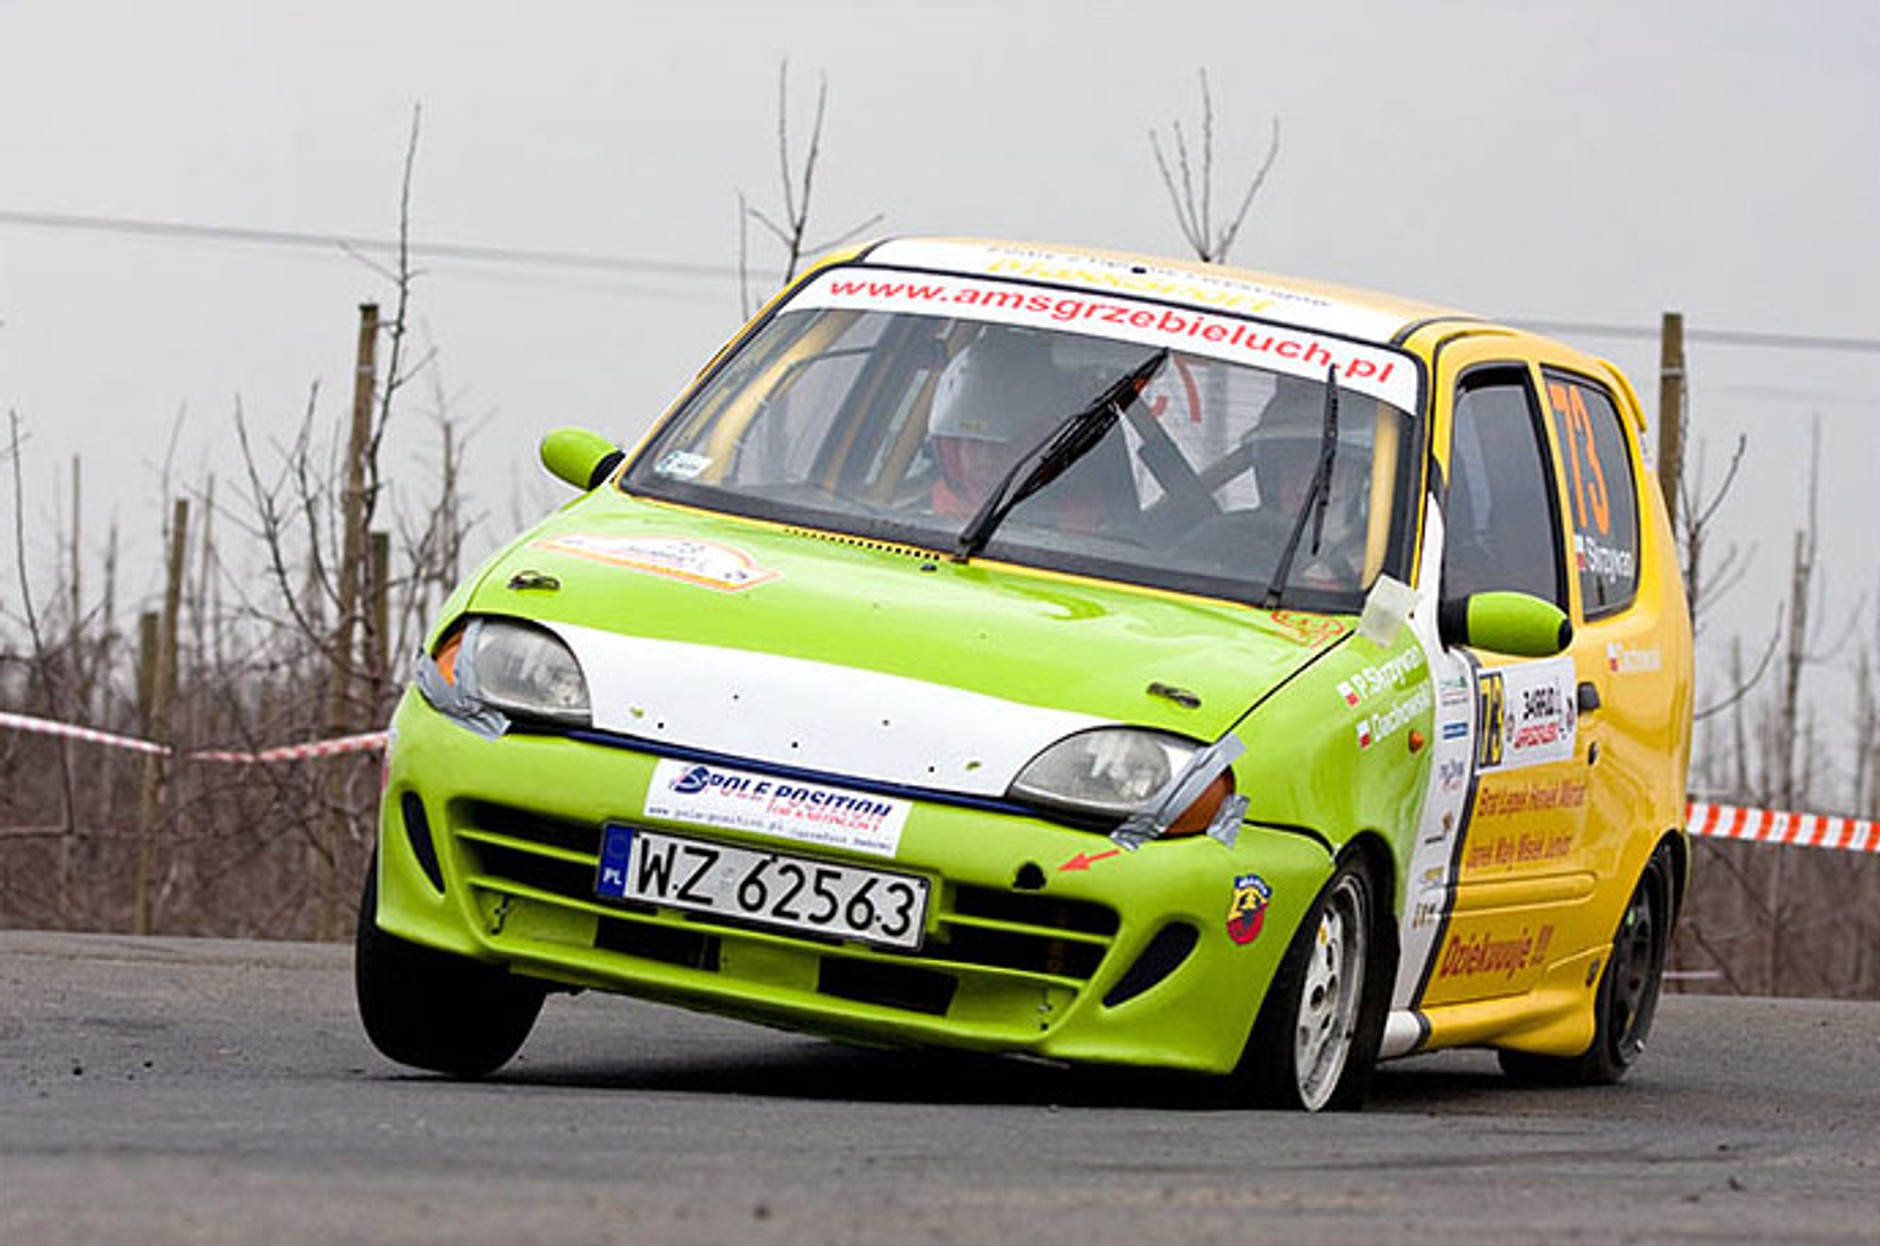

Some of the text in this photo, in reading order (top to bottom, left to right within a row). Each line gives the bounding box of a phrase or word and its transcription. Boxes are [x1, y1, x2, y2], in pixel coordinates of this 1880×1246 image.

[829, 278, 1396, 384] www.amsgrzebieluch.pl
[1548, 383, 1611, 536] 73
[775, 783, 893, 817] POSITION
[602, 867, 622, 886] PL
[637, 837, 917, 937] WZ 62563
